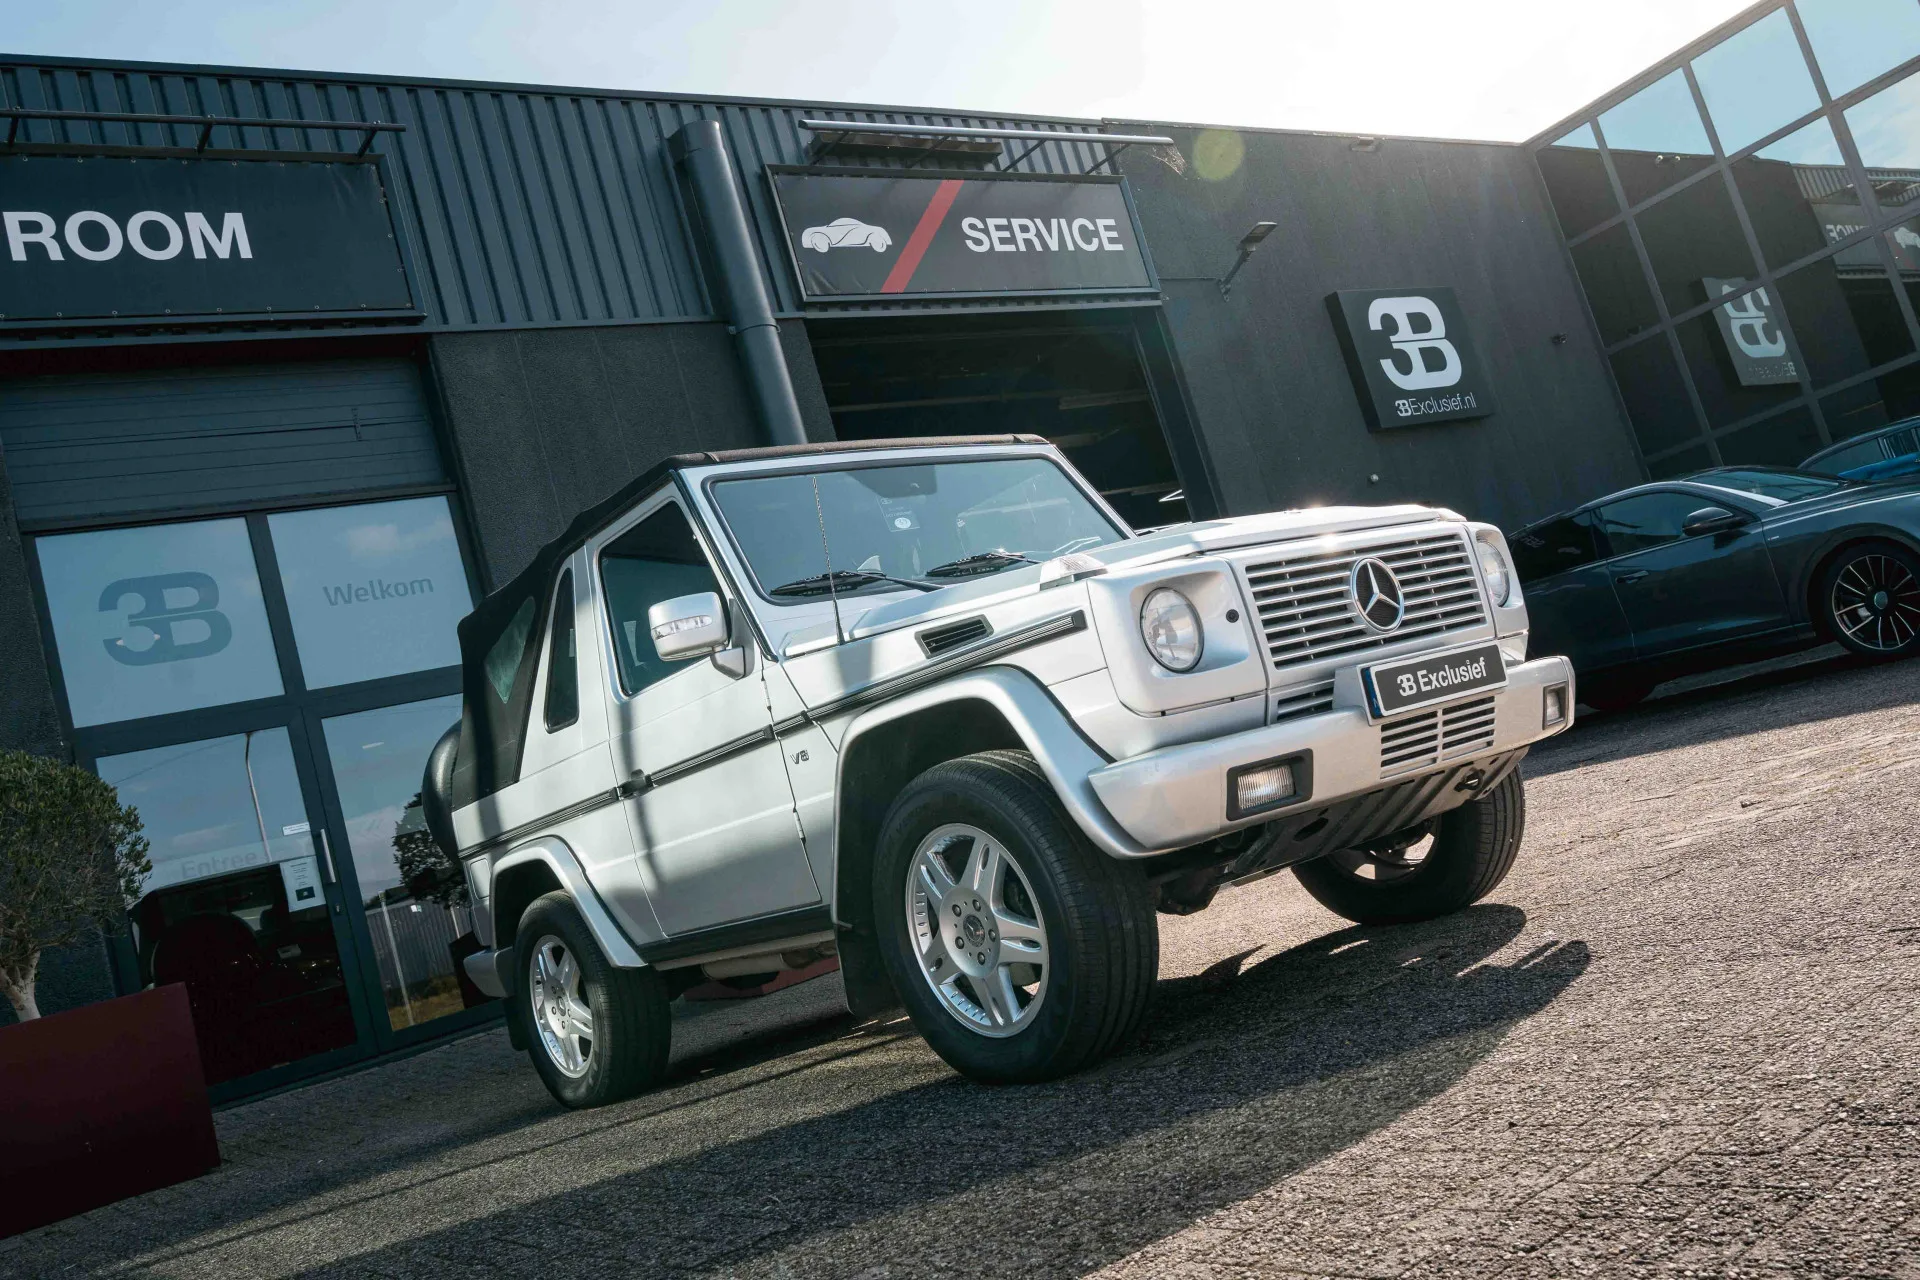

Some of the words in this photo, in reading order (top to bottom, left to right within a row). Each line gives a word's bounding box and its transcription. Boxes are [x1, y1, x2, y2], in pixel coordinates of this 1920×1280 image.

[2, 210, 253, 262] ROOM
[960, 216, 1125, 253] SERVICE
[322, 578, 434, 607] Welkom
[1416, 656, 1487, 692] Exclusief
[789, 749, 810, 765] V8
[180, 850, 259, 880] Entree
